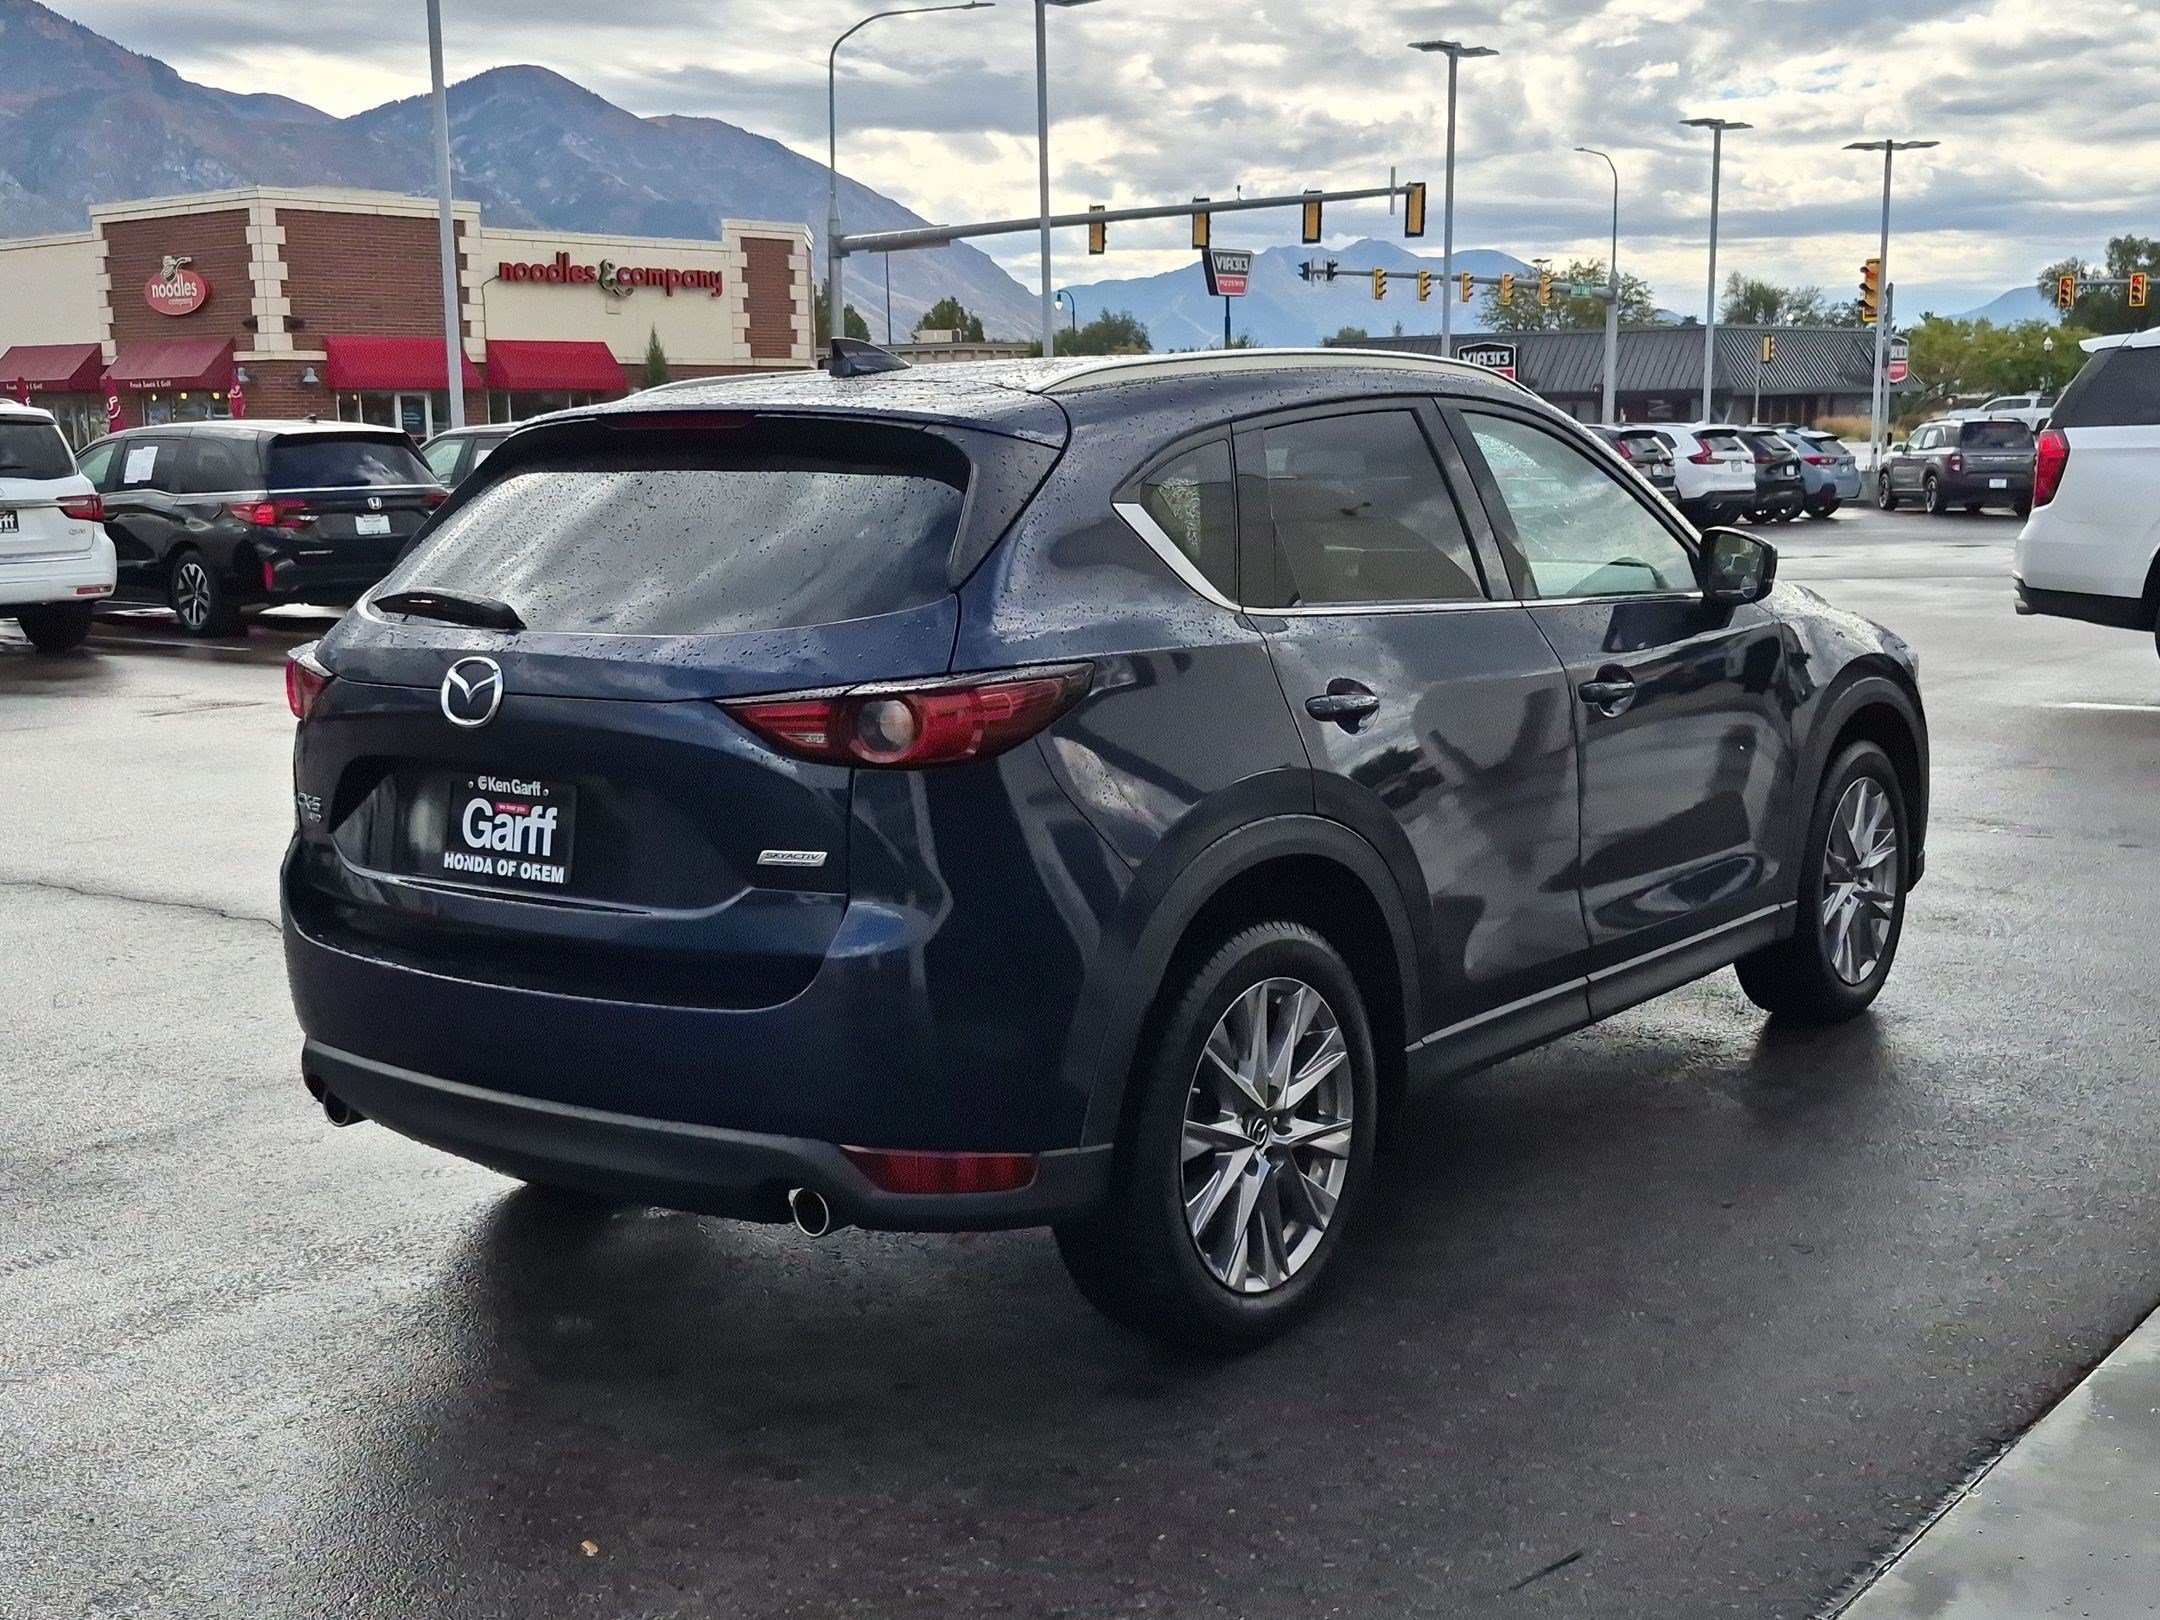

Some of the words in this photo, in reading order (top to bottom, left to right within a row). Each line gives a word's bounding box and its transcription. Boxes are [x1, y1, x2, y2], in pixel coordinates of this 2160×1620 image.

[151, 273, 198, 298] noodles
[499, 251, 597, 284] noodles
[616, 266, 724, 298] company
[462, 797, 558, 857] Garff
[443, 852, 493, 874] HONDA
[497, 859, 517, 877] OF
[520, 861, 565, 884] OREM
[765, 852, 825, 860] SKYACTIV
